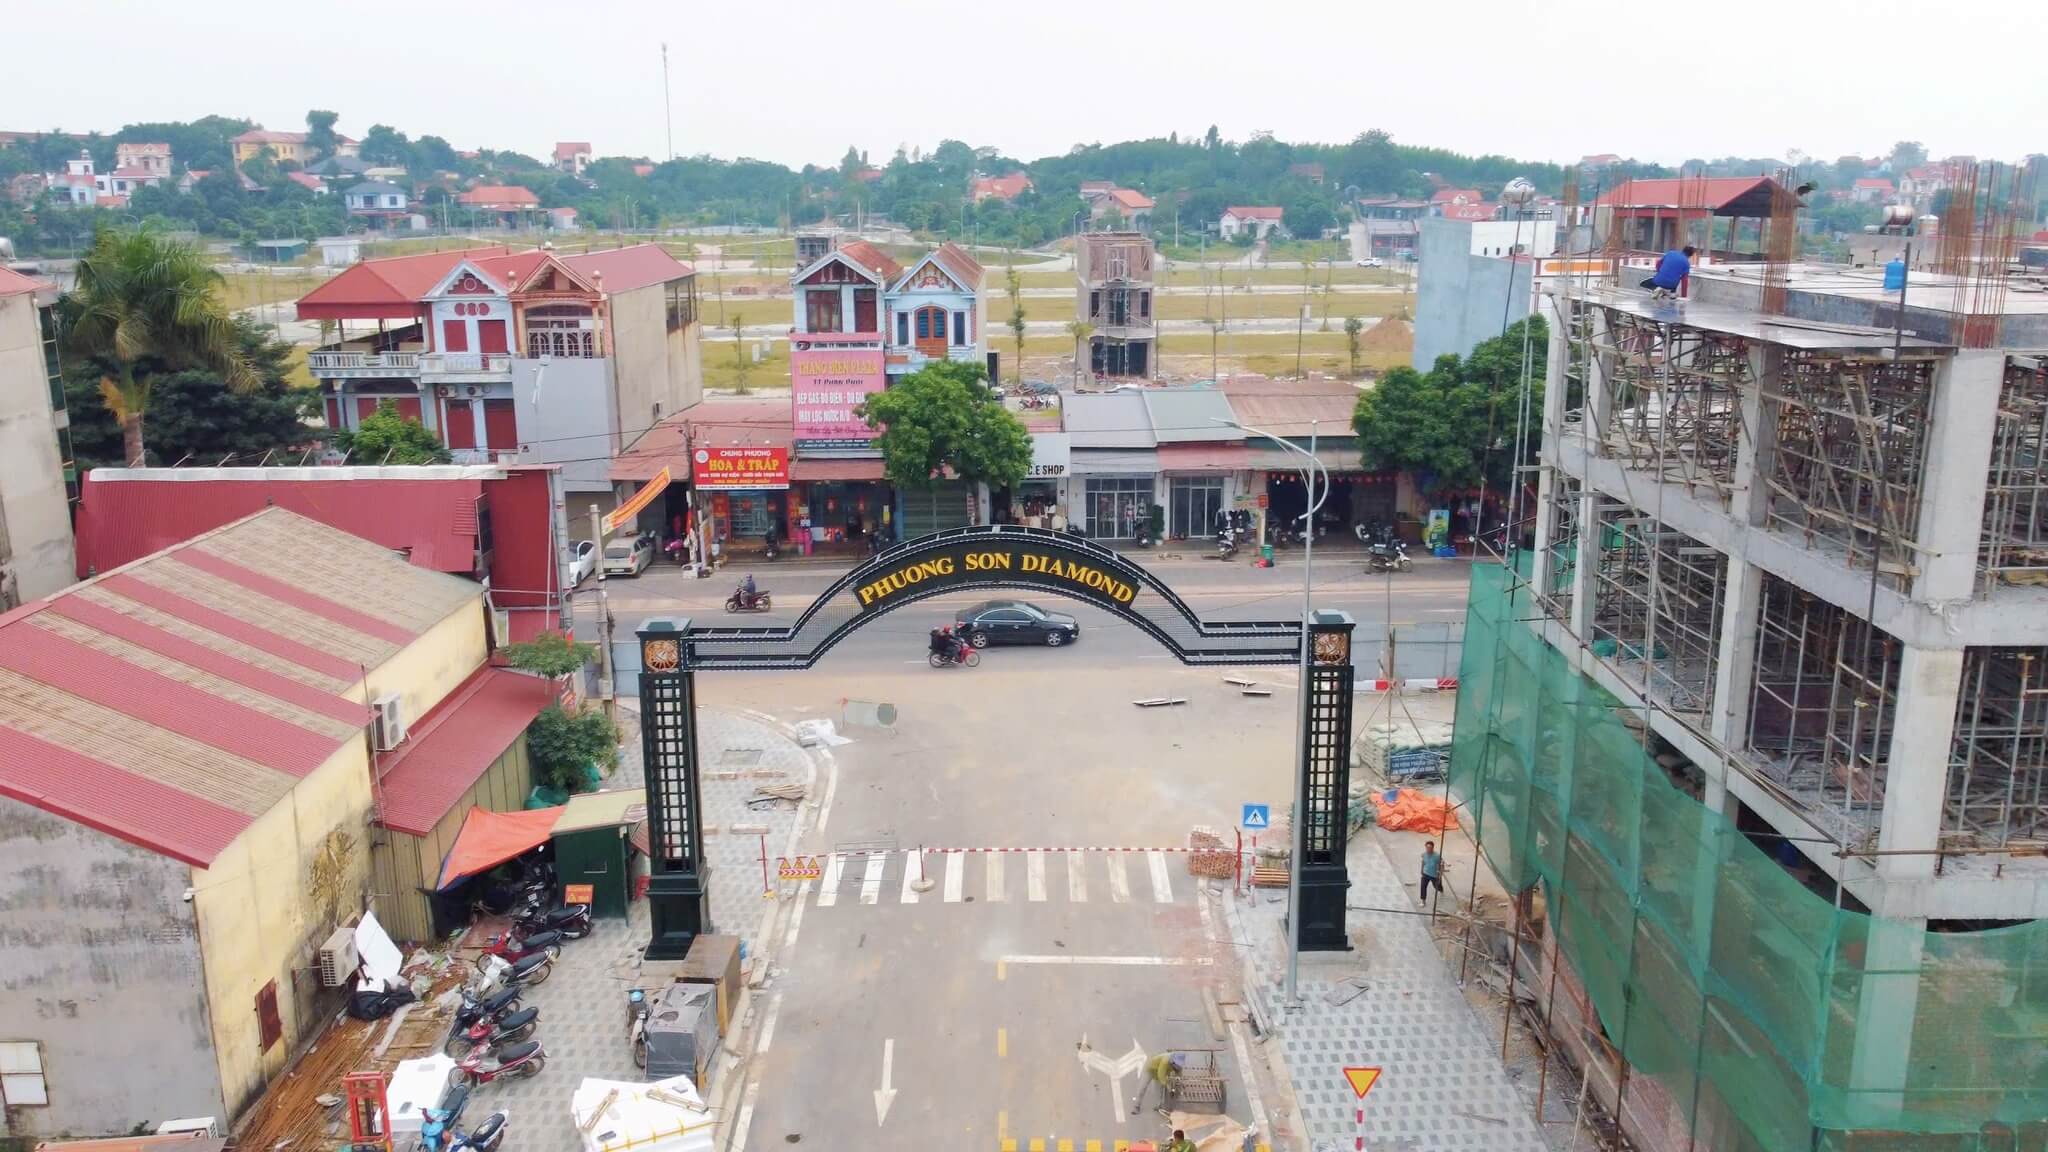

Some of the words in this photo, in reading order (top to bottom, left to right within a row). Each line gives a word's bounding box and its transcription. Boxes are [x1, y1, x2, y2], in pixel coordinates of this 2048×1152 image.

[709, 459, 733, 471] HOA
[737, 459, 745, 471] &
[1042, 464, 1064, 475] SHOP
[858, 557, 955, 605] PHUONG
[965, 552, 1011, 570] SON
[1021, 554, 1133, 602] DIAMOND
